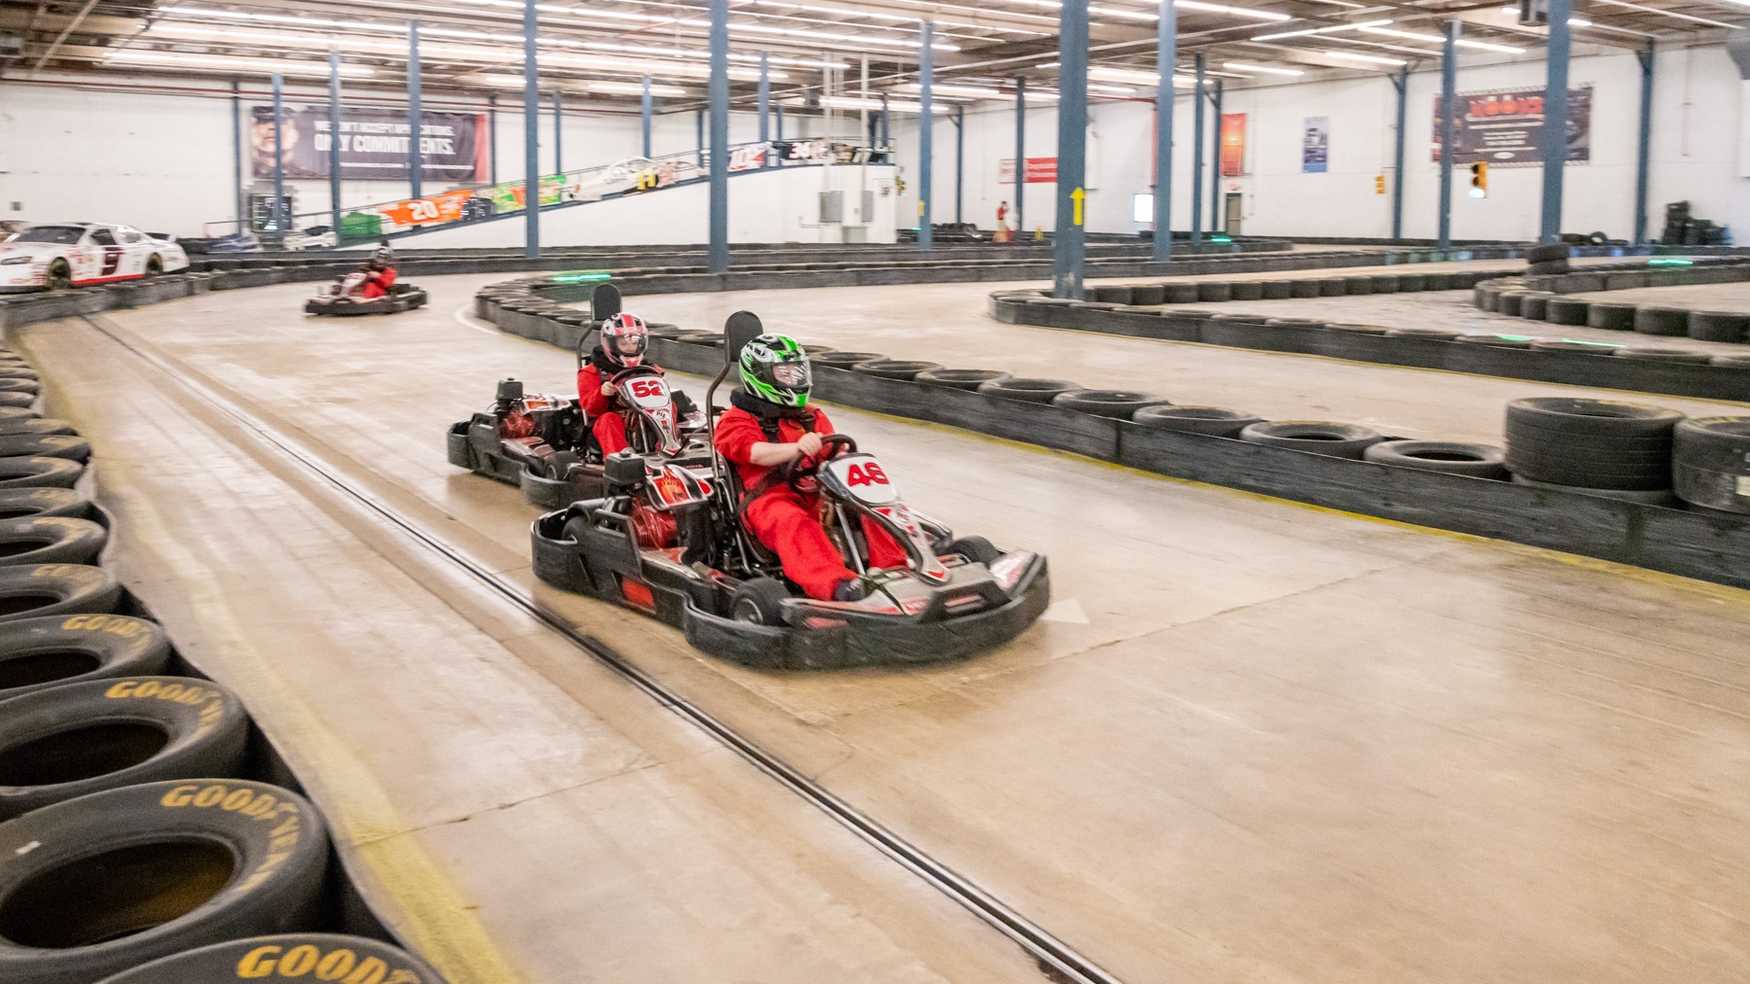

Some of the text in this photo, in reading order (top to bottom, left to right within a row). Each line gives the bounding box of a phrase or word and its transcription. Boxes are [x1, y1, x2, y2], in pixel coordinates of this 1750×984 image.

[314, 134, 350, 151] ONY
[407, 200, 439, 220] 20
[631, 380, 663, 398] 52
